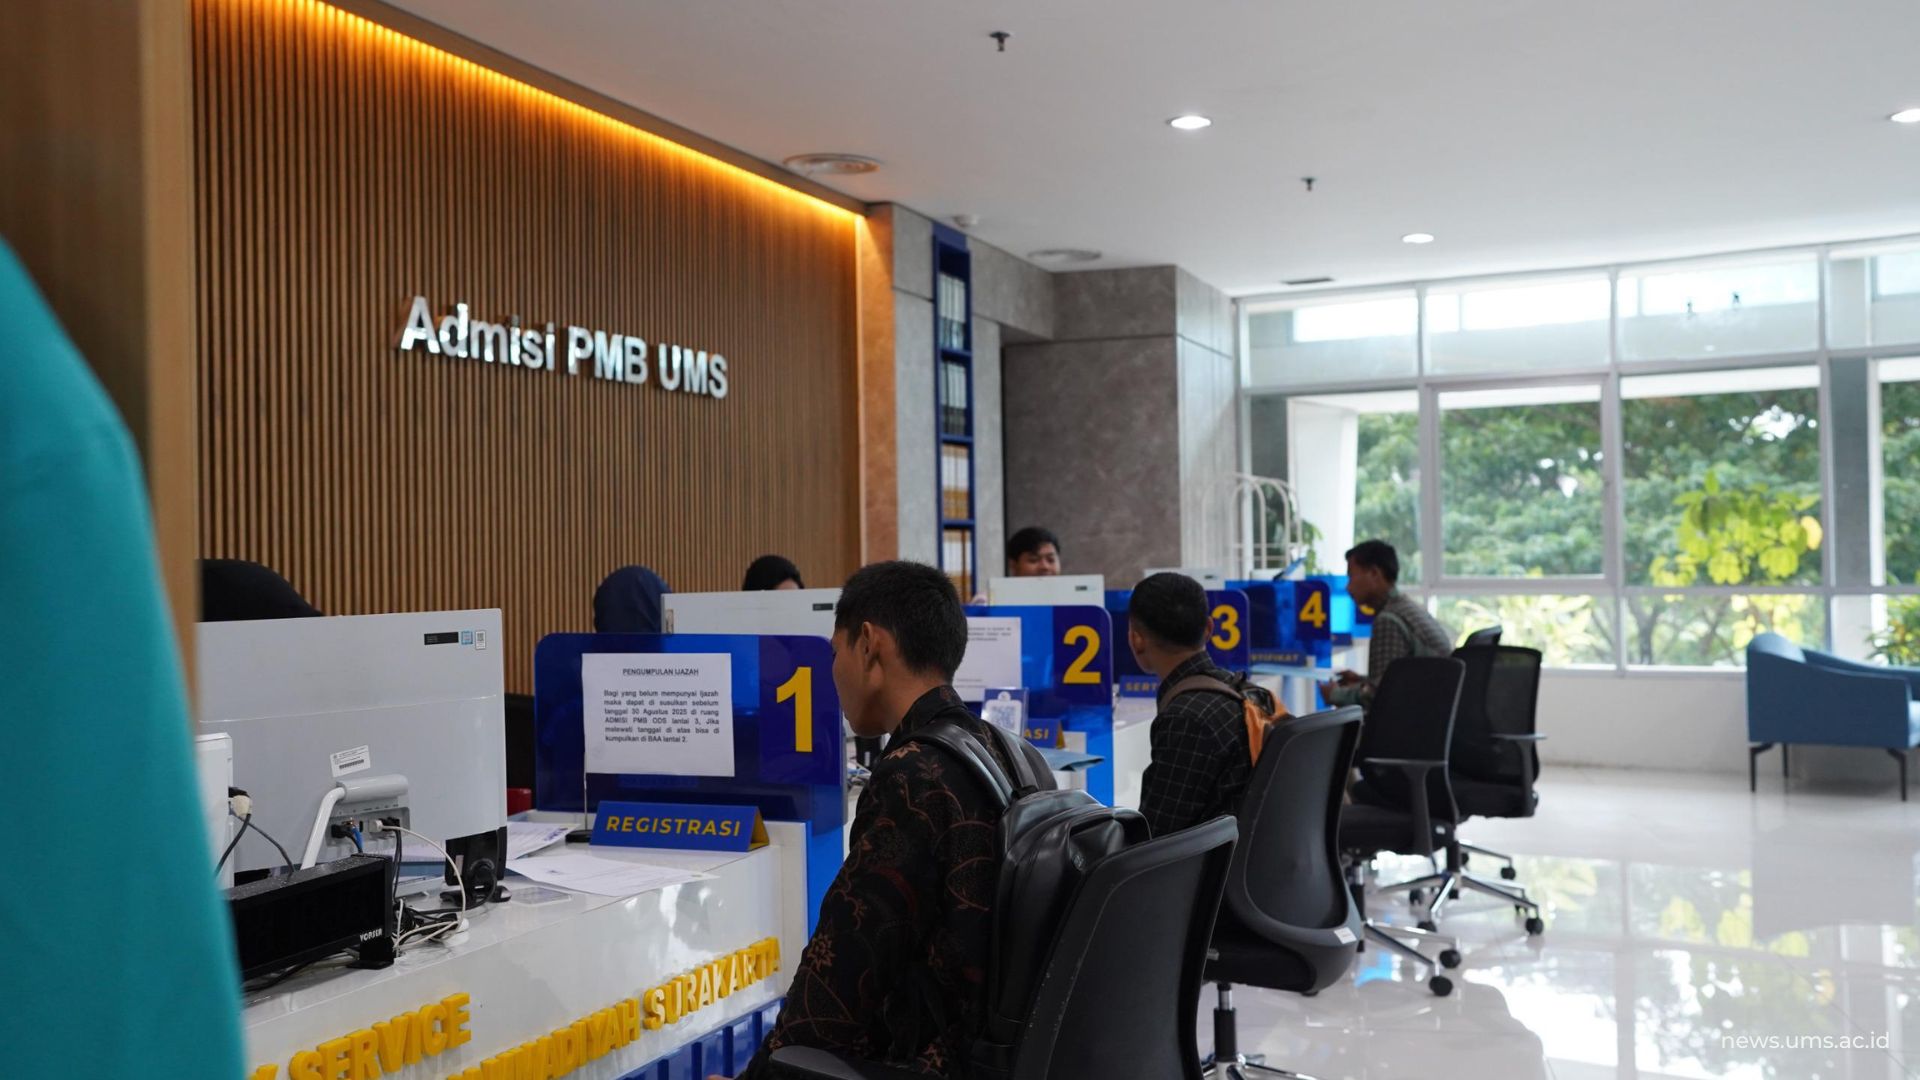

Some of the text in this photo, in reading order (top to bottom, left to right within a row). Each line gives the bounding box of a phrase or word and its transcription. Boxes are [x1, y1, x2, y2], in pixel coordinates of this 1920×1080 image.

[401, 296, 728, 399] Admisi PMB UMS
[1211, 604, 1241, 650] 3
[1299, 591, 1326, 628] 4
[622, 668, 673, 676] PENGUMPULAN
[1063, 625, 1101, 684] 2
[604, 690, 618, 698] Bagi
[661, 690, 697, 698] mempunyai
[604, 708, 628, 716] tanggal
[776, 666, 813, 753] 1
[605, 735, 639, 743] kumpulkan
[606, 816, 740, 837] REGISTRASI
[642, 936, 781, 1031] SURAKARTA
